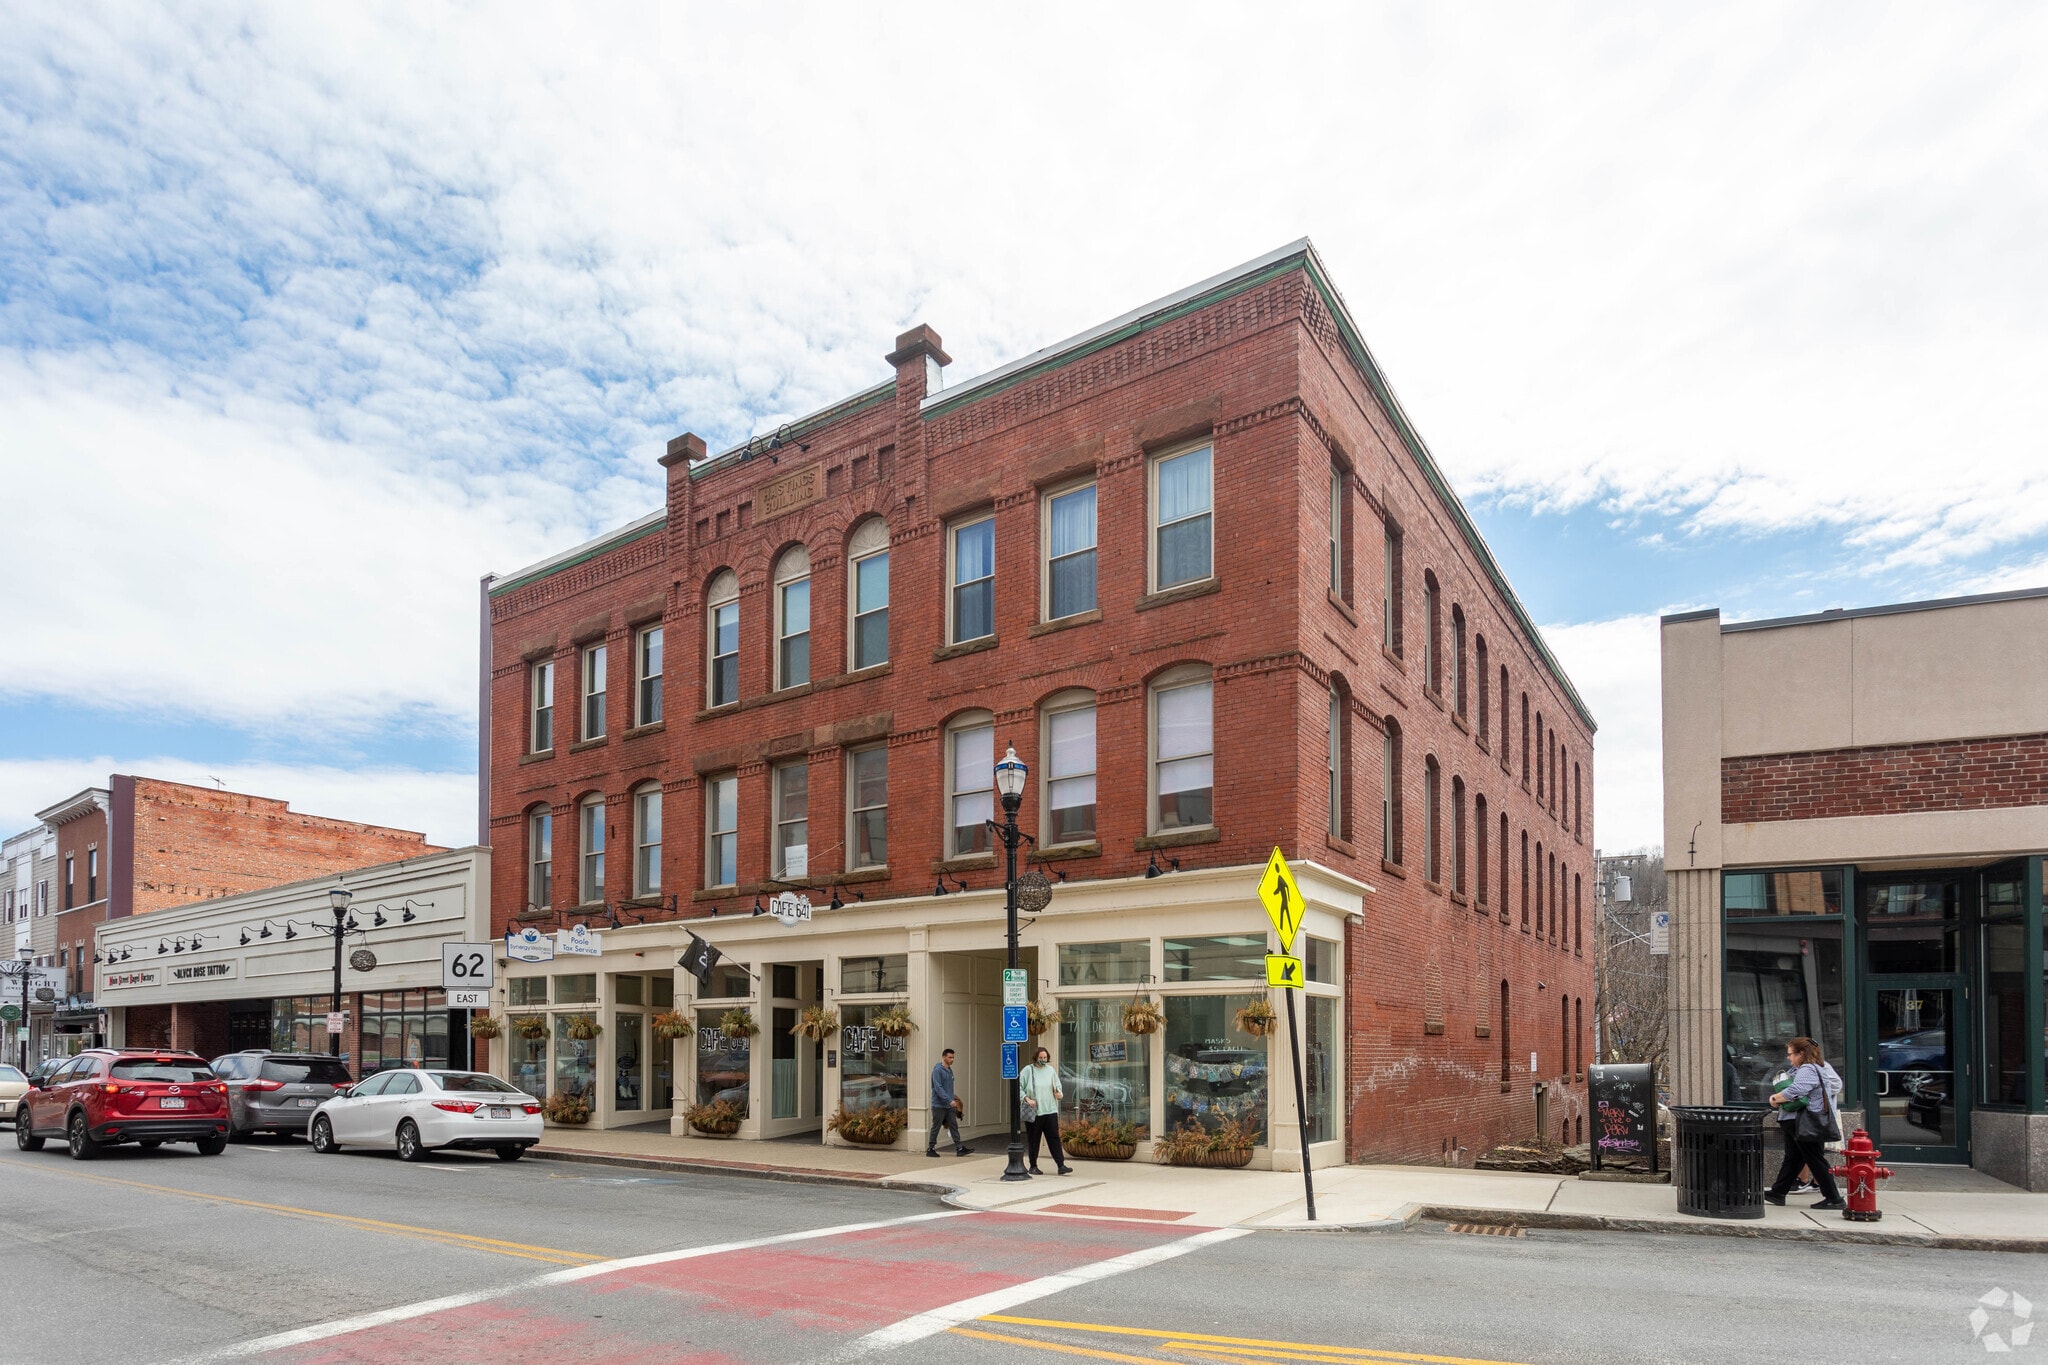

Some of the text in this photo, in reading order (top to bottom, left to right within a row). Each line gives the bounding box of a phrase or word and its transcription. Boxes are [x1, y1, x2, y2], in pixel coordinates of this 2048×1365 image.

[764, 472, 815, 502] HASTINGS
[766, 487, 813, 514] BUILDING
[772, 900, 810, 919] CAFE 641
[570, 936, 589, 946] Poole
[575, 945, 598, 954] Service
[193, 966, 206, 977] ROSE
[207, 964, 226, 976] TATTOO
[452, 953, 484, 978] 62
[109, 972, 155, 986] Main Street Bagel Factory
[1005, 971, 1011, 981] 2
[11, 979, 59, 988] WIGHT
[456, 994, 478, 1003] EAST
[1906, 1001, 1922, 1010] 37
[699, 1028, 728, 1051] CAFE
[844, 1026, 878, 1051] CAFE
